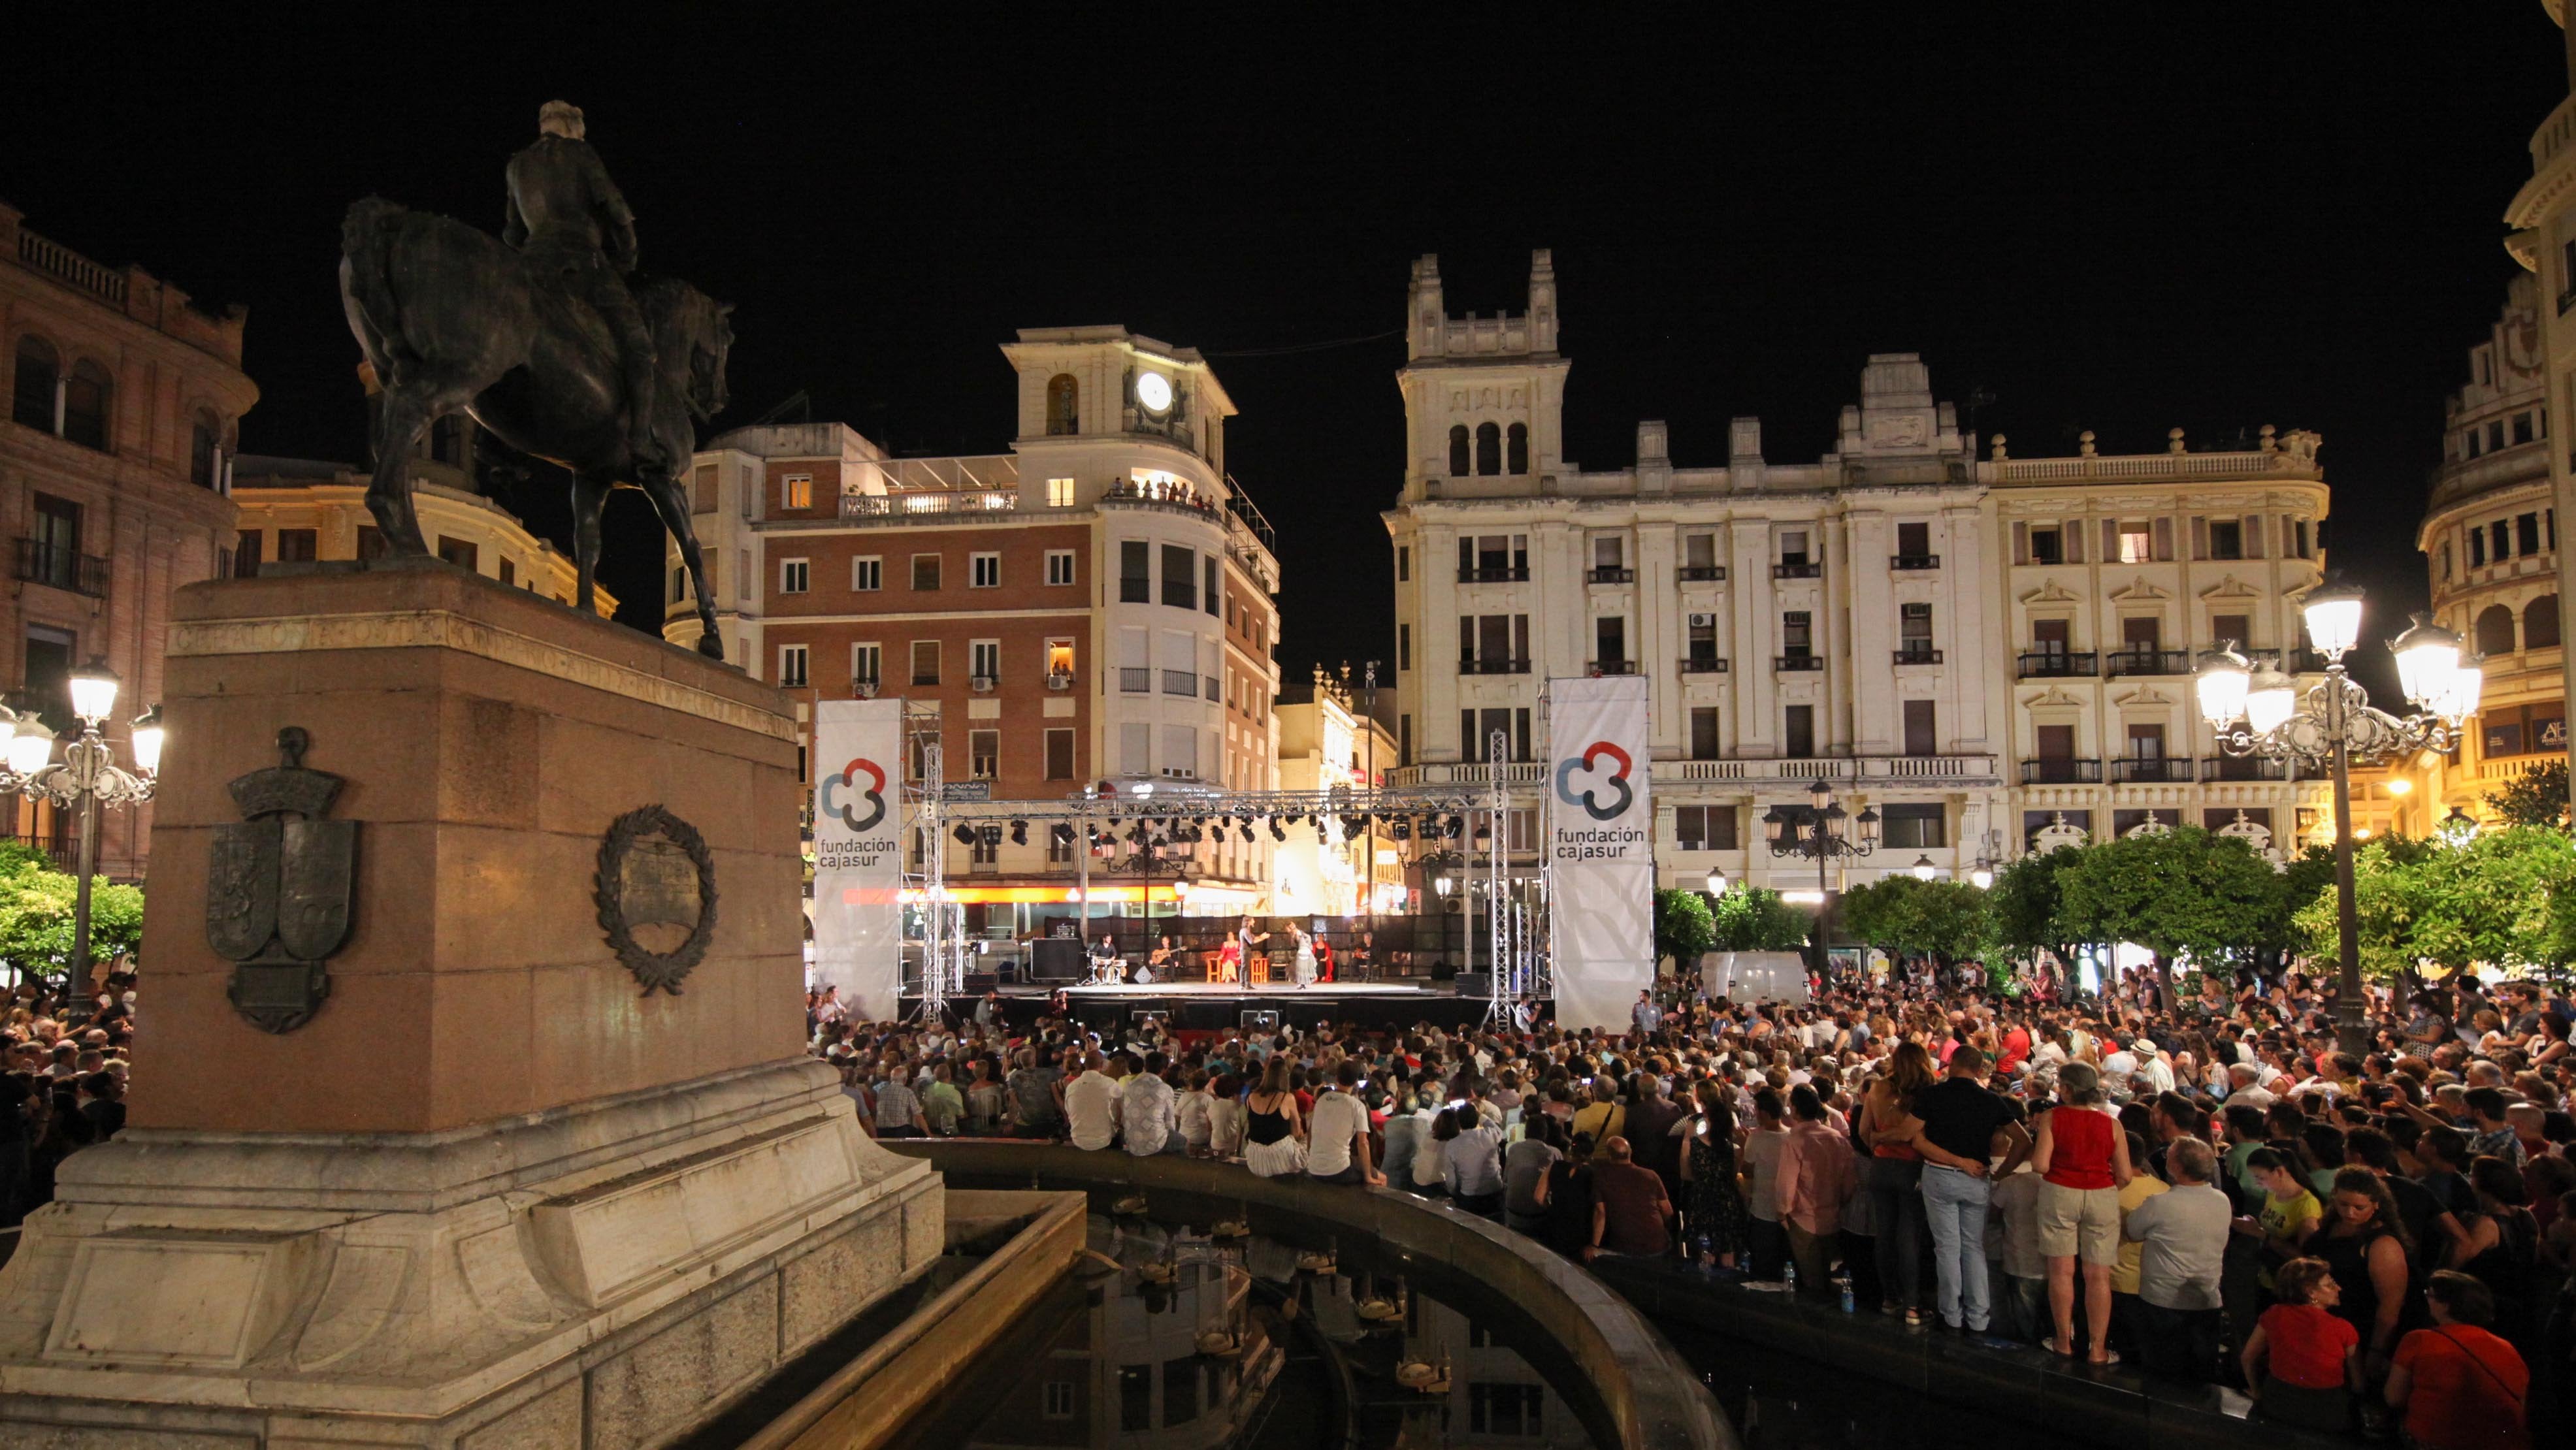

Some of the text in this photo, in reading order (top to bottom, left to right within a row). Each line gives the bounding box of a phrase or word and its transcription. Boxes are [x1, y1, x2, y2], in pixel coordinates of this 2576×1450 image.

[1557, 826, 1644, 843] fundación
[821, 837, 896, 853] fundación
[1557, 843, 1627, 862] cajasur
[820, 853, 879, 871] cajasur
